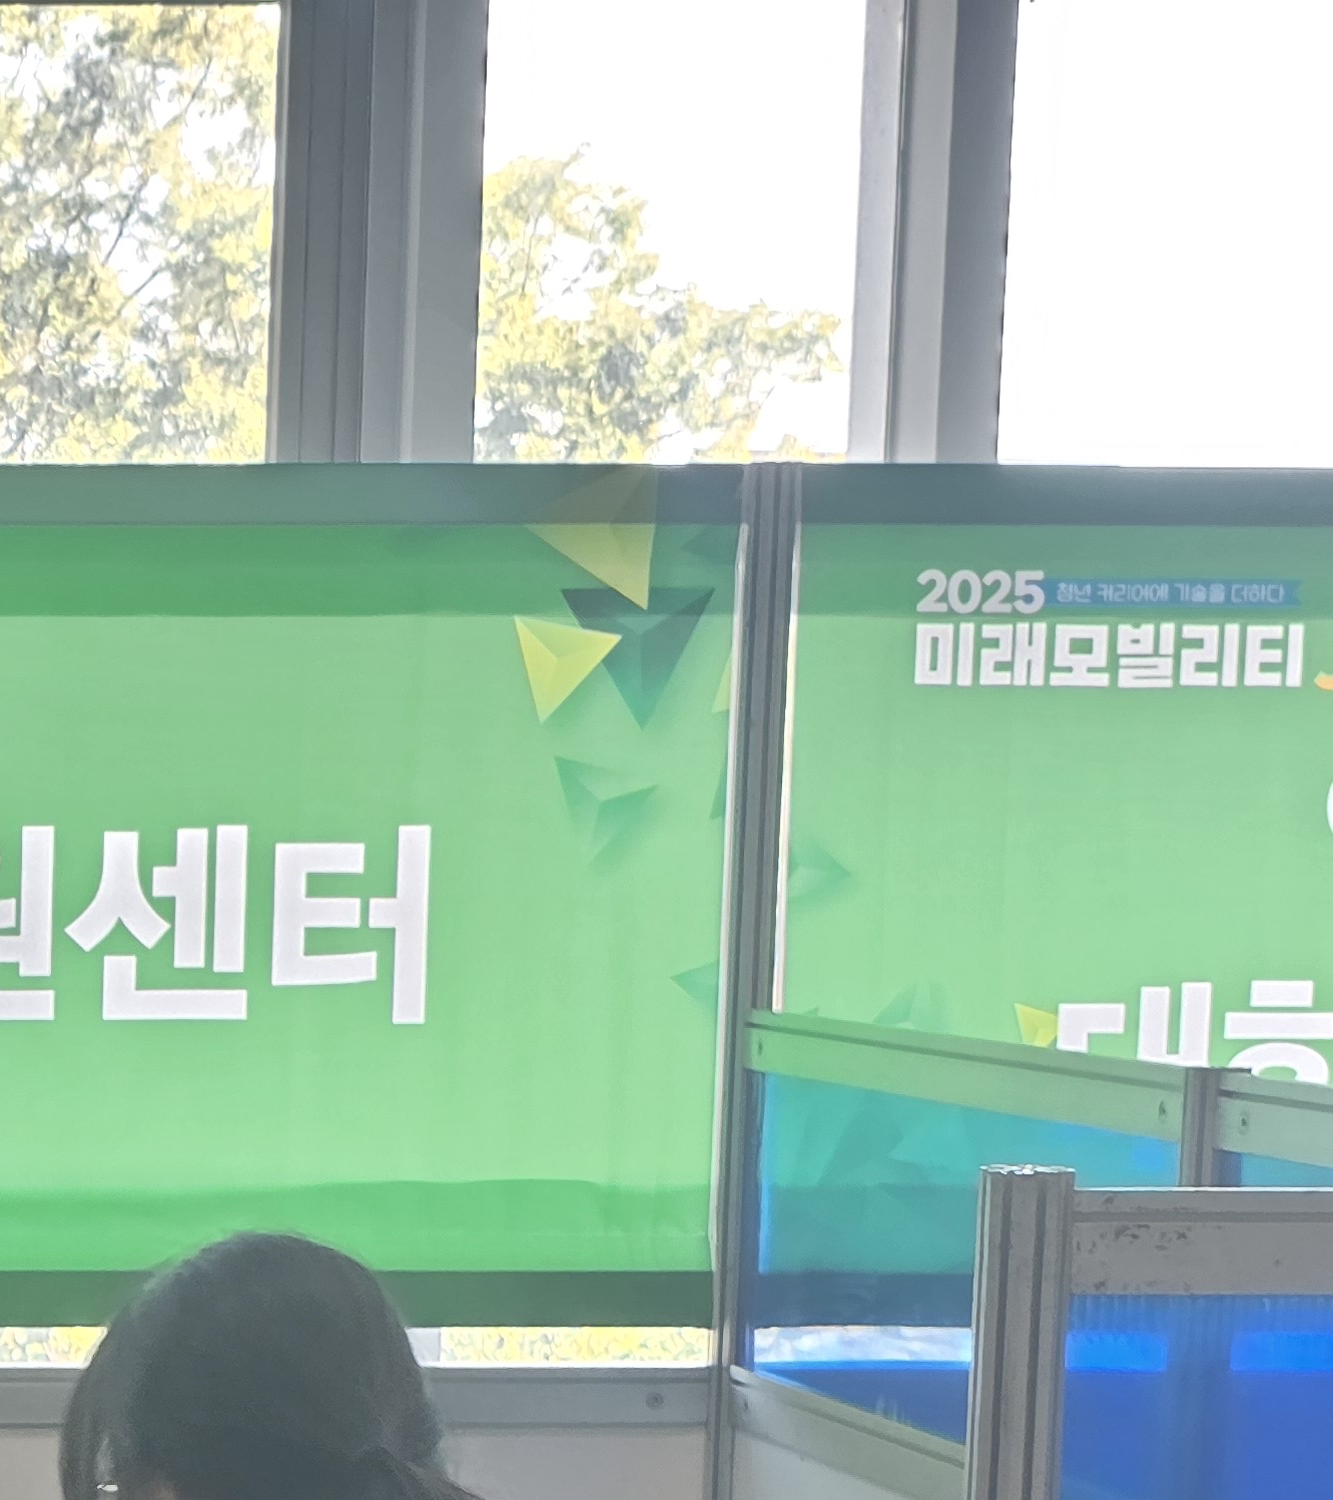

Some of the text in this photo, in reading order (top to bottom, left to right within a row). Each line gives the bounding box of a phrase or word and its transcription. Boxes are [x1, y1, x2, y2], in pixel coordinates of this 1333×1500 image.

[916, 568, 1046, 615] 2025
[1231, 582, 1286, 605] 더하다
[913, 620, 1306, 689] 미래모빌리티
